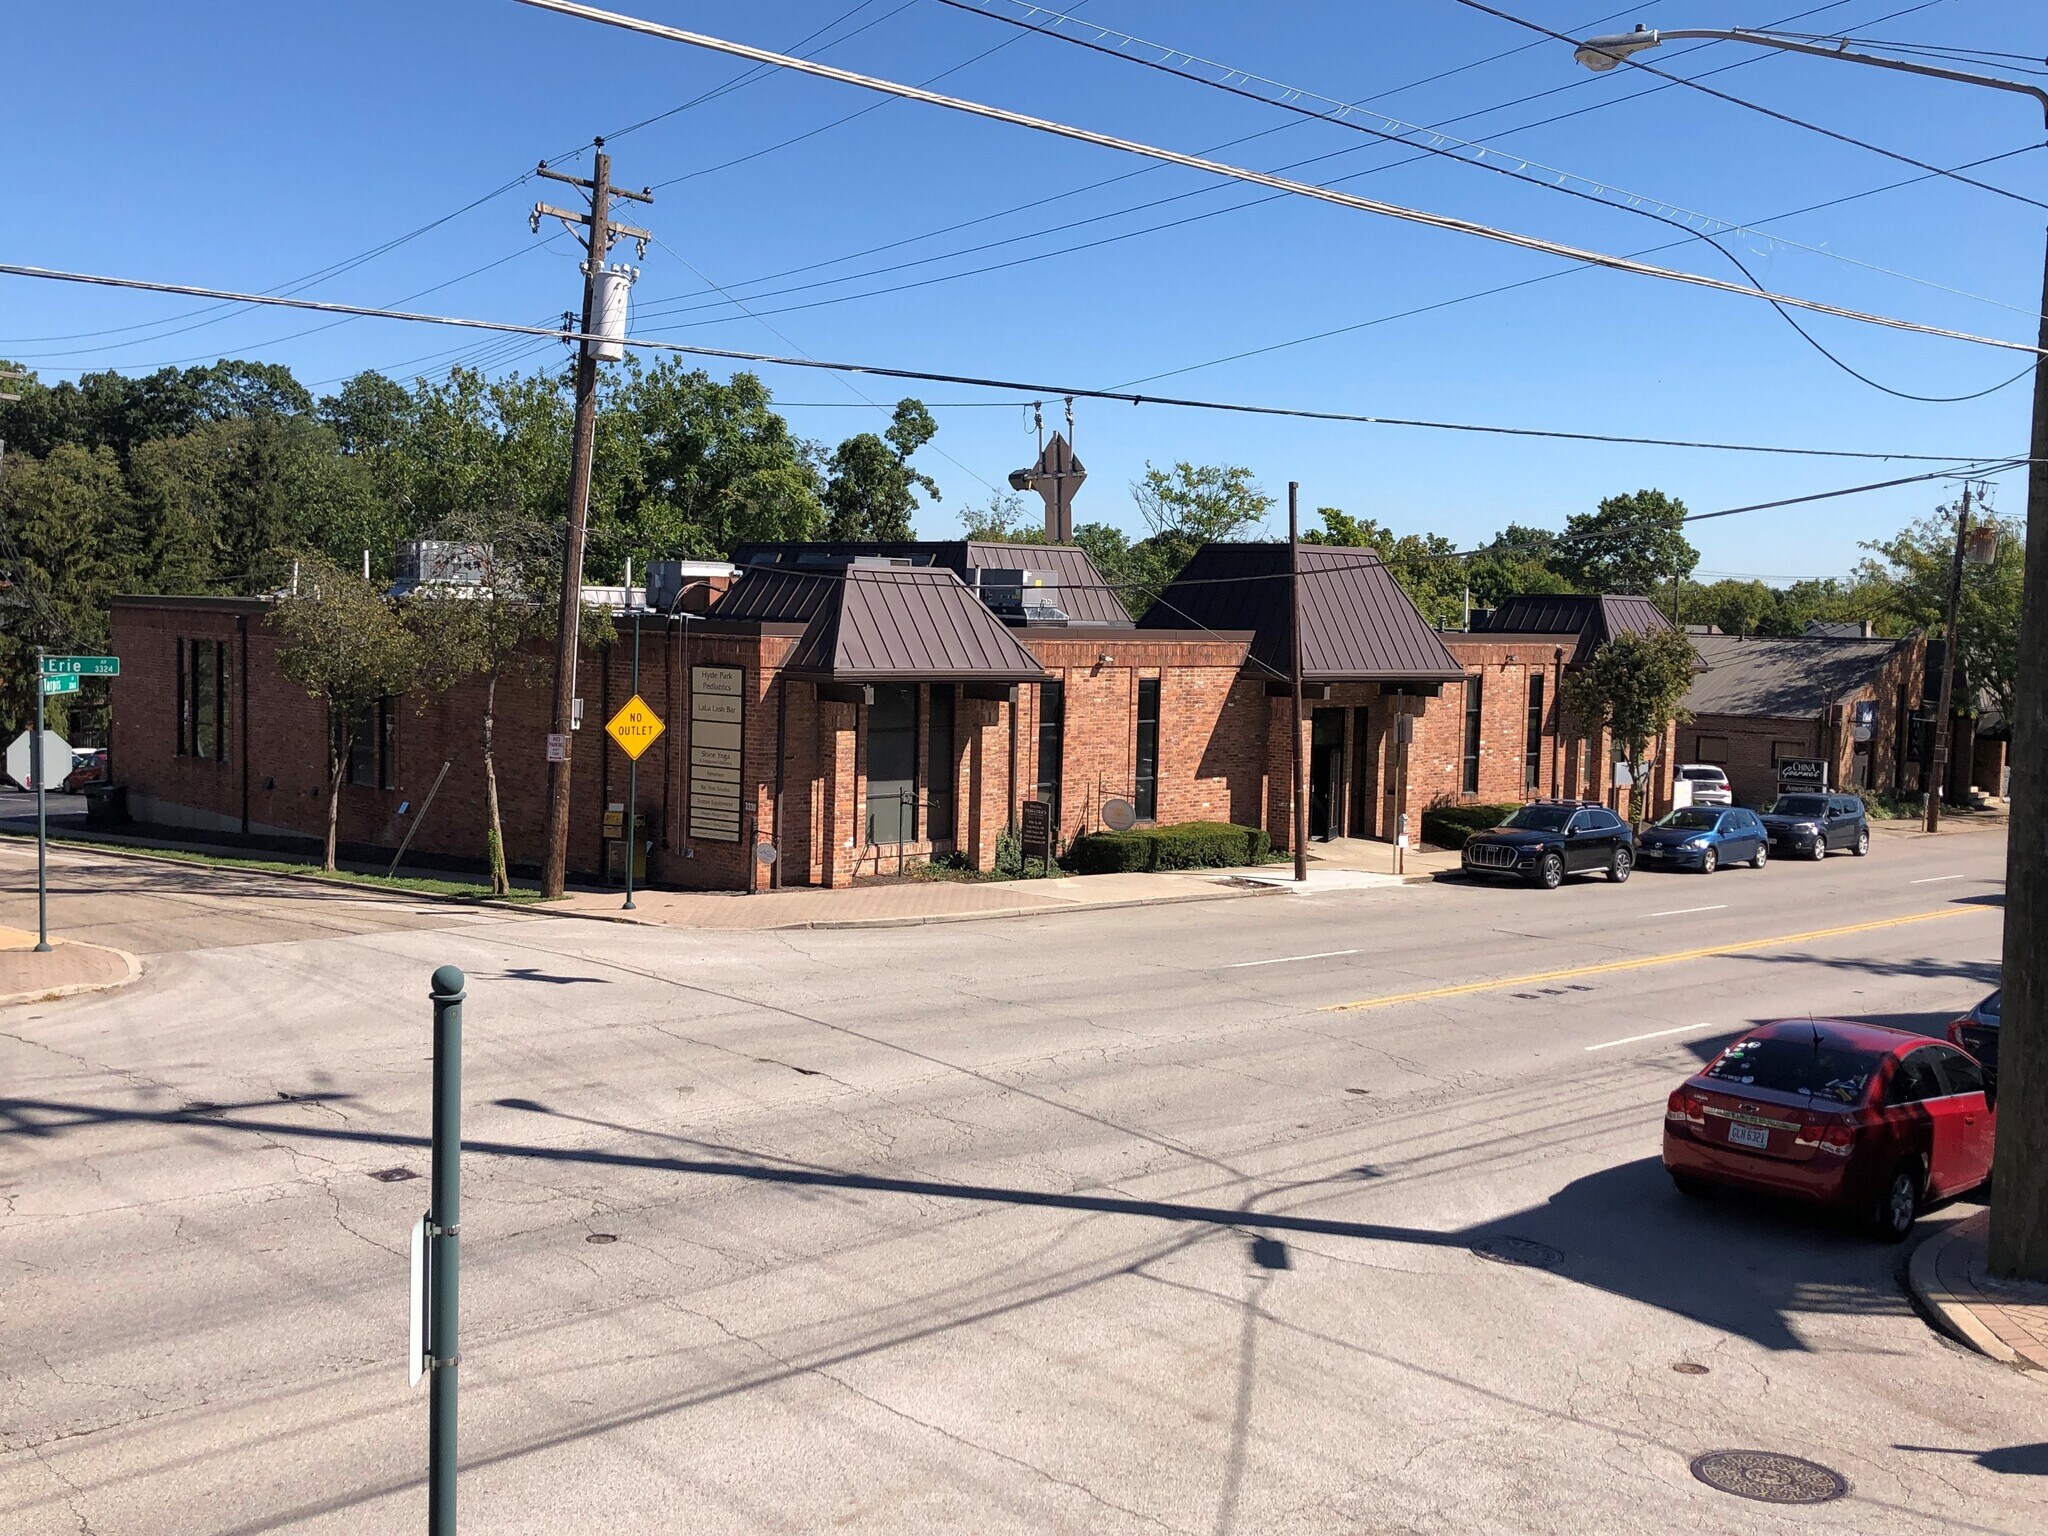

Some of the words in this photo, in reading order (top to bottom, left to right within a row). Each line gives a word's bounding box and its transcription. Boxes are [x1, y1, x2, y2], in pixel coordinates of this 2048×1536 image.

[49, 659, 81, 672] Erie
[95, 665, 113, 673] 3324
[701, 671, 718, 680] Hyde
[719, 671, 733, 680] Park
[702, 682, 731, 691] Pediatrics
[698, 704, 711, 712] LaLa
[712, 705, 725, 713] Lash
[726, 706, 736, 714] Bar
[630, 712, 642, 723] NO
[618, 725, 653, 736] OUTLET
[701, 750, 716, 759] Shine
[717, 751, 731, 761] Yoga
[1782, 765, 1820, 778] Gourmet
[1792, 762, 1816, 772] CHINA
[1785, 784, 1816, 793] Assembly
[1746, 1129, 1765, 1144] 6321
